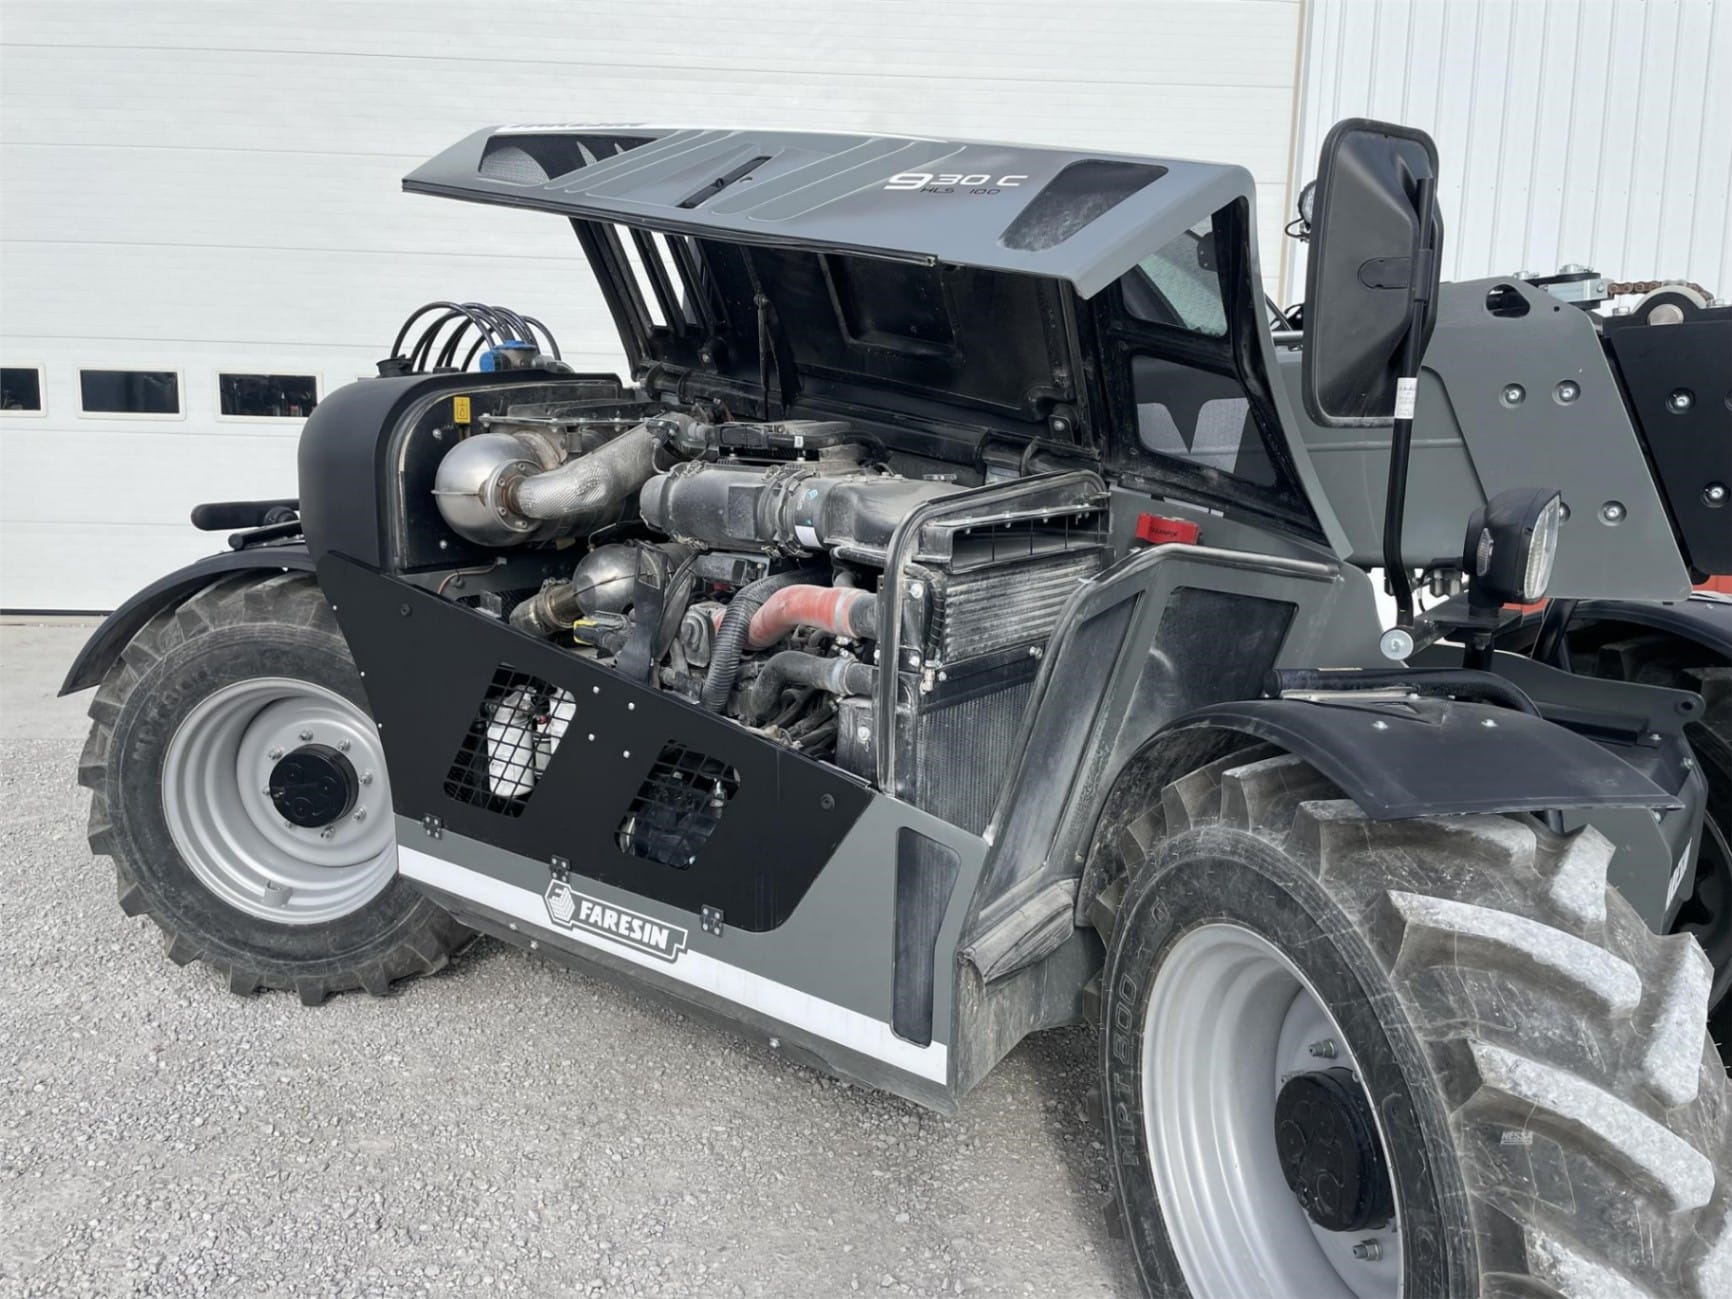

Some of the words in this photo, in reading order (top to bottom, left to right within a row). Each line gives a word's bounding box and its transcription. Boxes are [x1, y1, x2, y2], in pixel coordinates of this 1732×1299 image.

[883, 172, 992, 190] 930
[996, 174, 1029, 187] C
[920, 187, 955, 195] HLS
[969, 188, 1001, 196] 100
[578, 899, 670, 951] FARESIN
[1112, 973, 1137, 1065] 800
[1113, 1072, 1139, 1166] MPT
